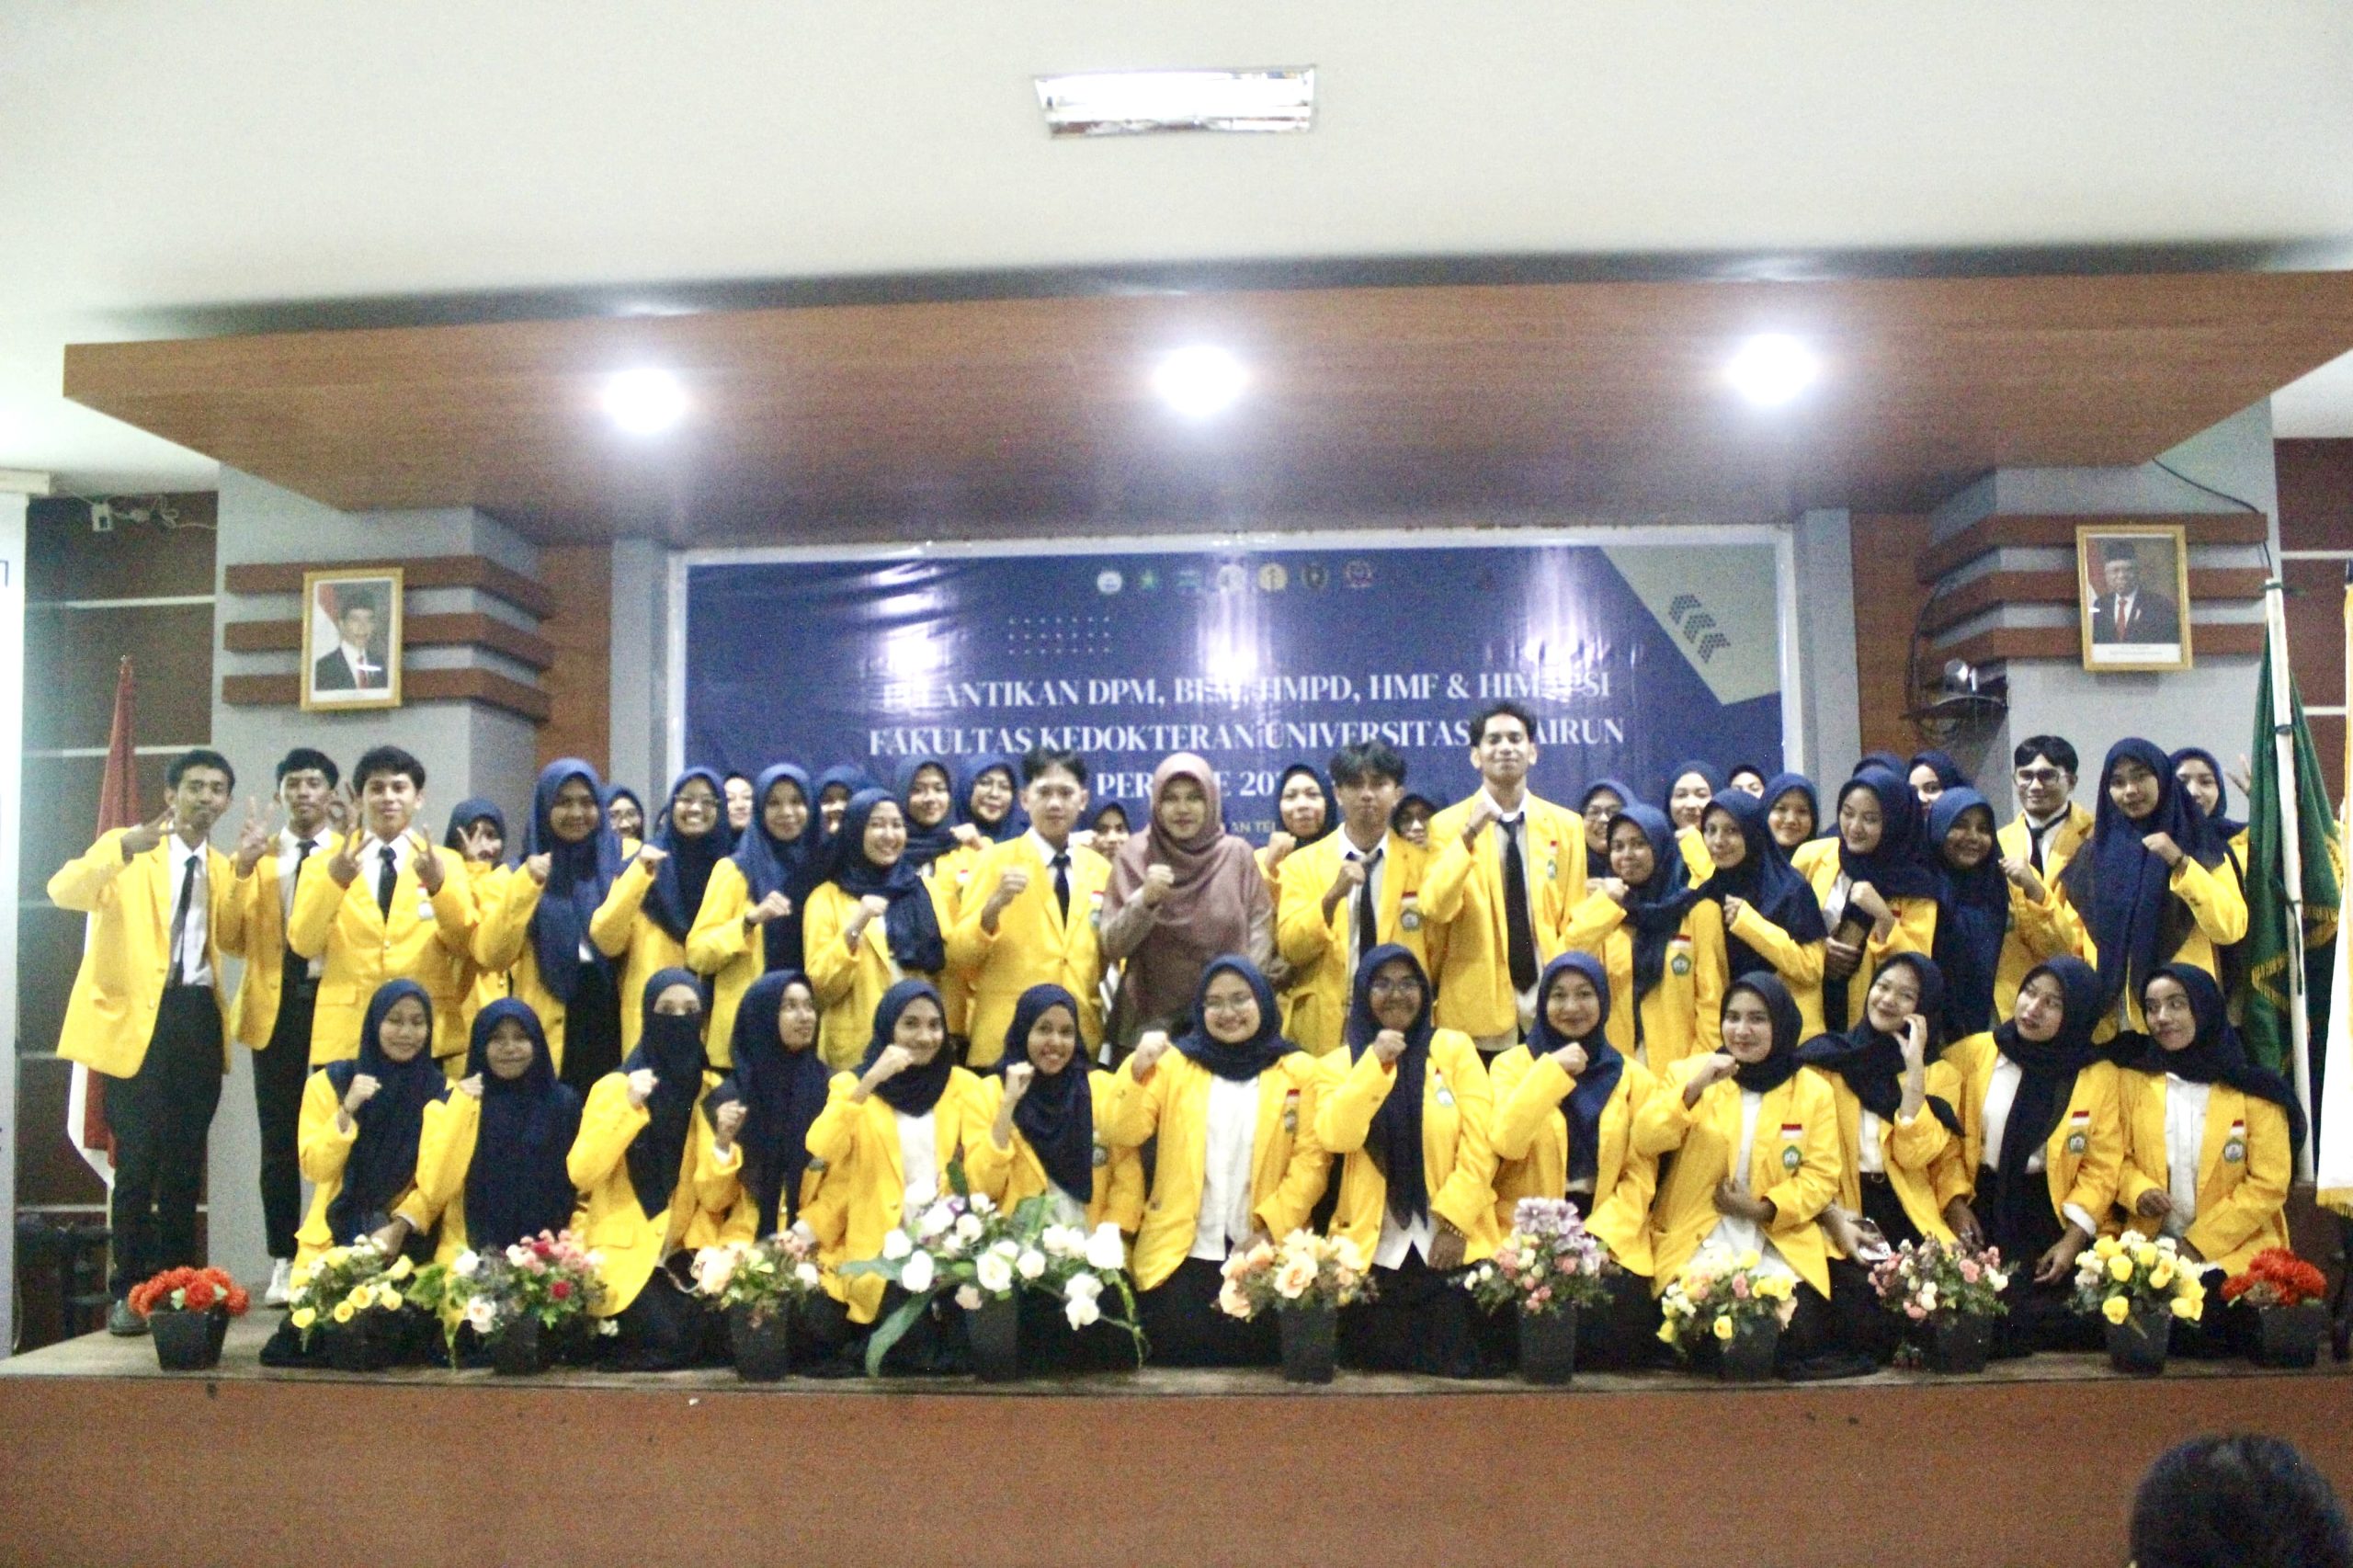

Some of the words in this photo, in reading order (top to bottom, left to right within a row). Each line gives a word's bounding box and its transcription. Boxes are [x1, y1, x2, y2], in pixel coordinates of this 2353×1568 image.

[1087, 677, 1165, 708] DPM,
[1259, 674, 1361, 705] HMPD,
[1370, 673, 1439, 701] HMF
[1446, 672, 1471, 699] &
[870, 725, 1034, 756] FAKULTAS
[1040, 722, 1259, 752] KEDOKTERAN
[1263, 719, 1471, 749] UNIVERSITAS
